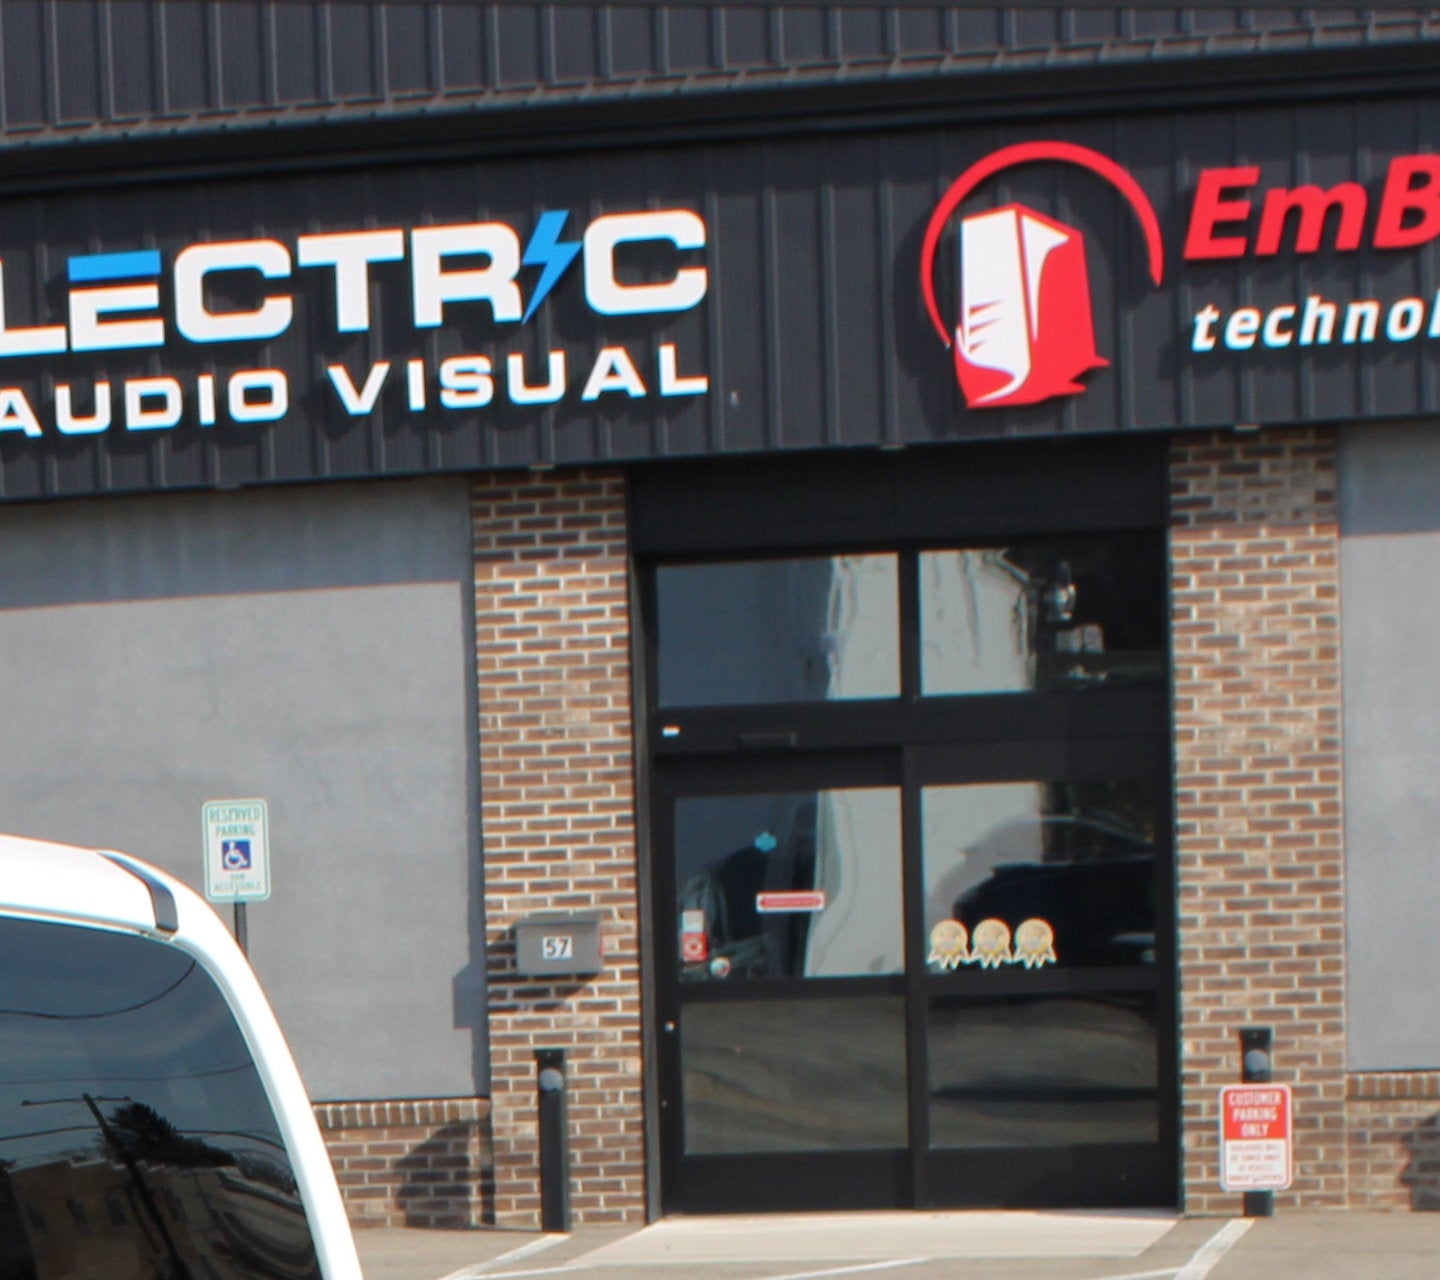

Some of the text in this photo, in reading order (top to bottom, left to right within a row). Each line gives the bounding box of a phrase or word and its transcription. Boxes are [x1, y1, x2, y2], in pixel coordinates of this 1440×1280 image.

[328, 343, 708, 415] VISUAL
[208, 806, 261, 822] RESERVED
[216, 823, 256, 836] PARKING
[546, 937, 570, 957] 57
[1228, 1091, 1281, 1106] CUSTOMER
[1232, 1106, 1278, 1122] PARKING
[1240, 1122, 1270, 1137] ONLY
